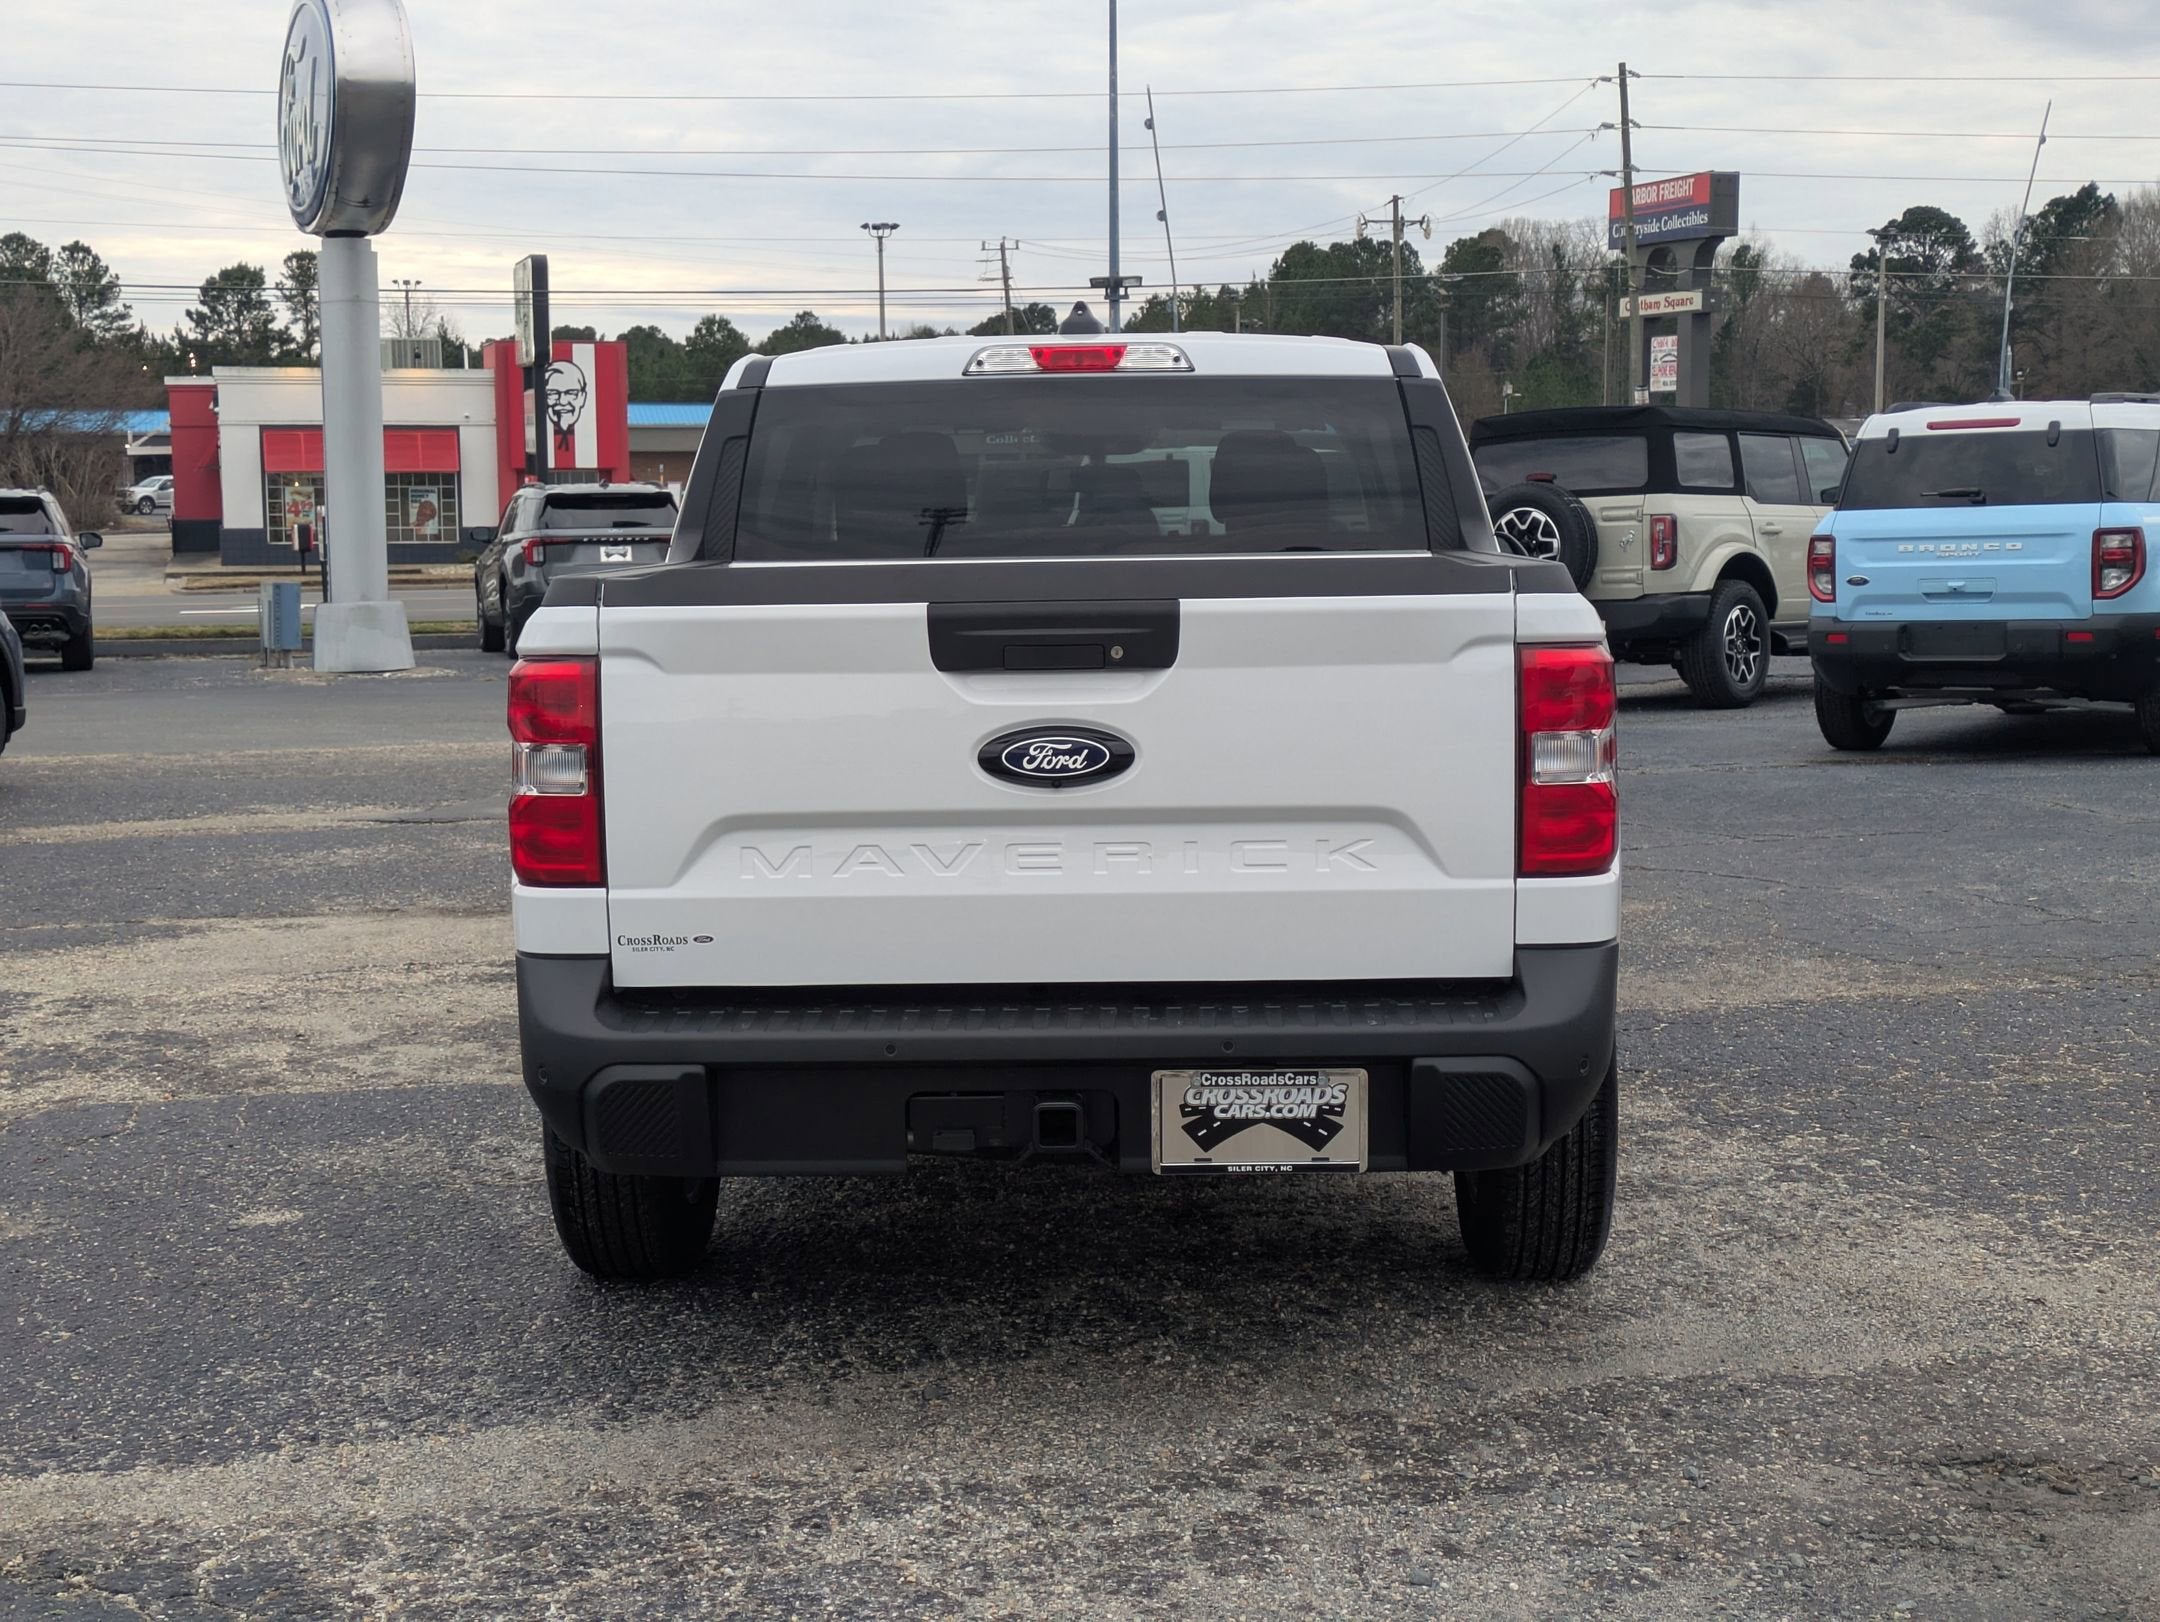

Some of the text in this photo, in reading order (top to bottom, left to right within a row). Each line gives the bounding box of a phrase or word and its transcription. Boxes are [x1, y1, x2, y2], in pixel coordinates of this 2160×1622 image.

[1632, 178, 1695, 206] ARBOR FREIGHT
[1661, 210, 1708, 232] Collectibles
[1663, 295, 1694, 310] Square
[1898, 542, 2022, 553] BRONCO
[1022, 743, 1088, 769] Ford
[740, 838, 1378, 879] MAVERICK
[1201, 1072, 1317, 1086] CrossRoadsCars
[1184, 1083, 1349, 1106] CROSSROADS
[1213, 1103, 1319, 1119] CARS.COM
